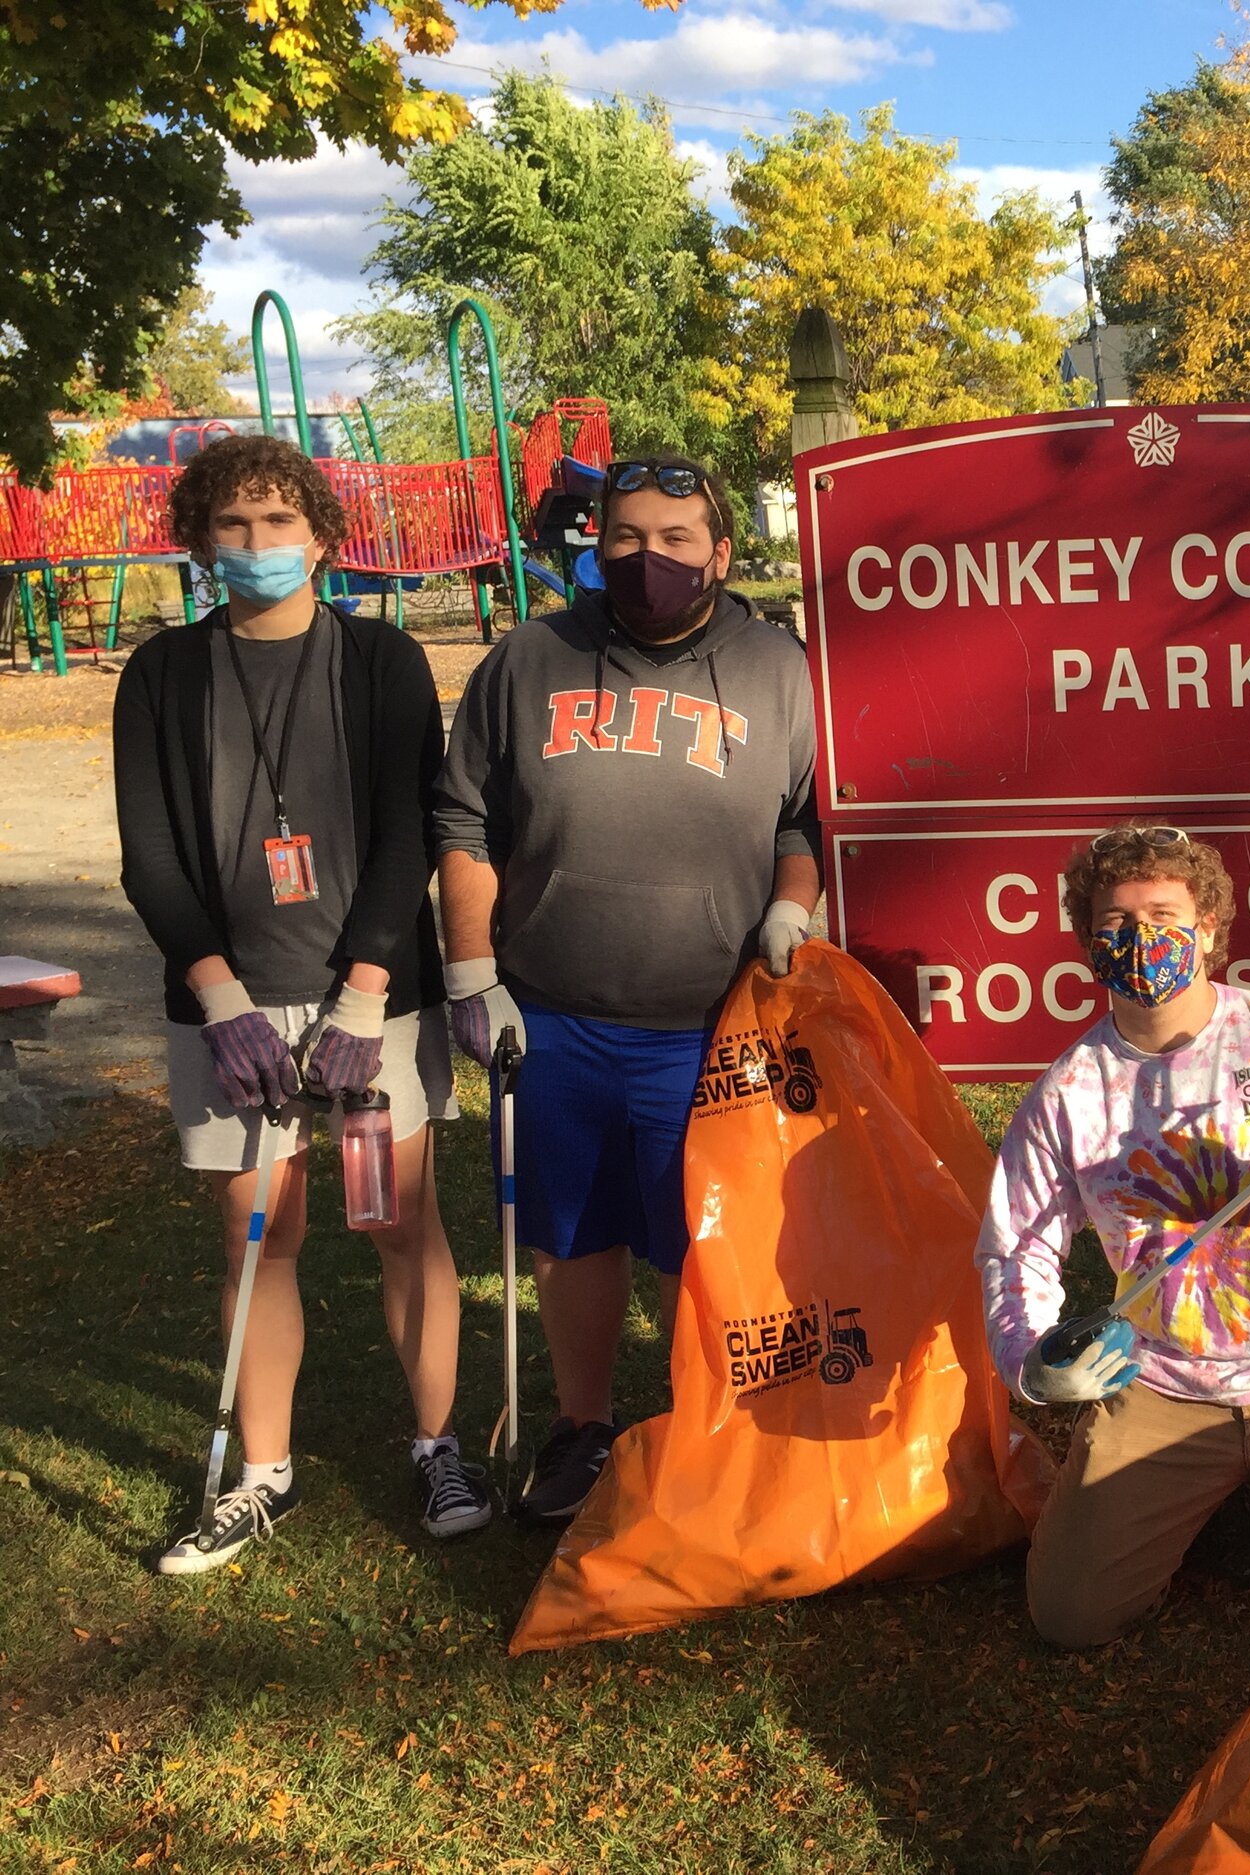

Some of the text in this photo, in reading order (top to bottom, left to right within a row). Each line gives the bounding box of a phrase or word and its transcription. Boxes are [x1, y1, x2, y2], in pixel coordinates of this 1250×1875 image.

[847, 536, 1143, 612] CONKEY
[543, 687, 748, 778] RIT
[985, 872, 1074, 934] CI
[700, 1038, 780, 1078] LEAN
[726, 1313, 821, 1358] CLEAN
[731, 1339, 823, 1387] SWEEP
